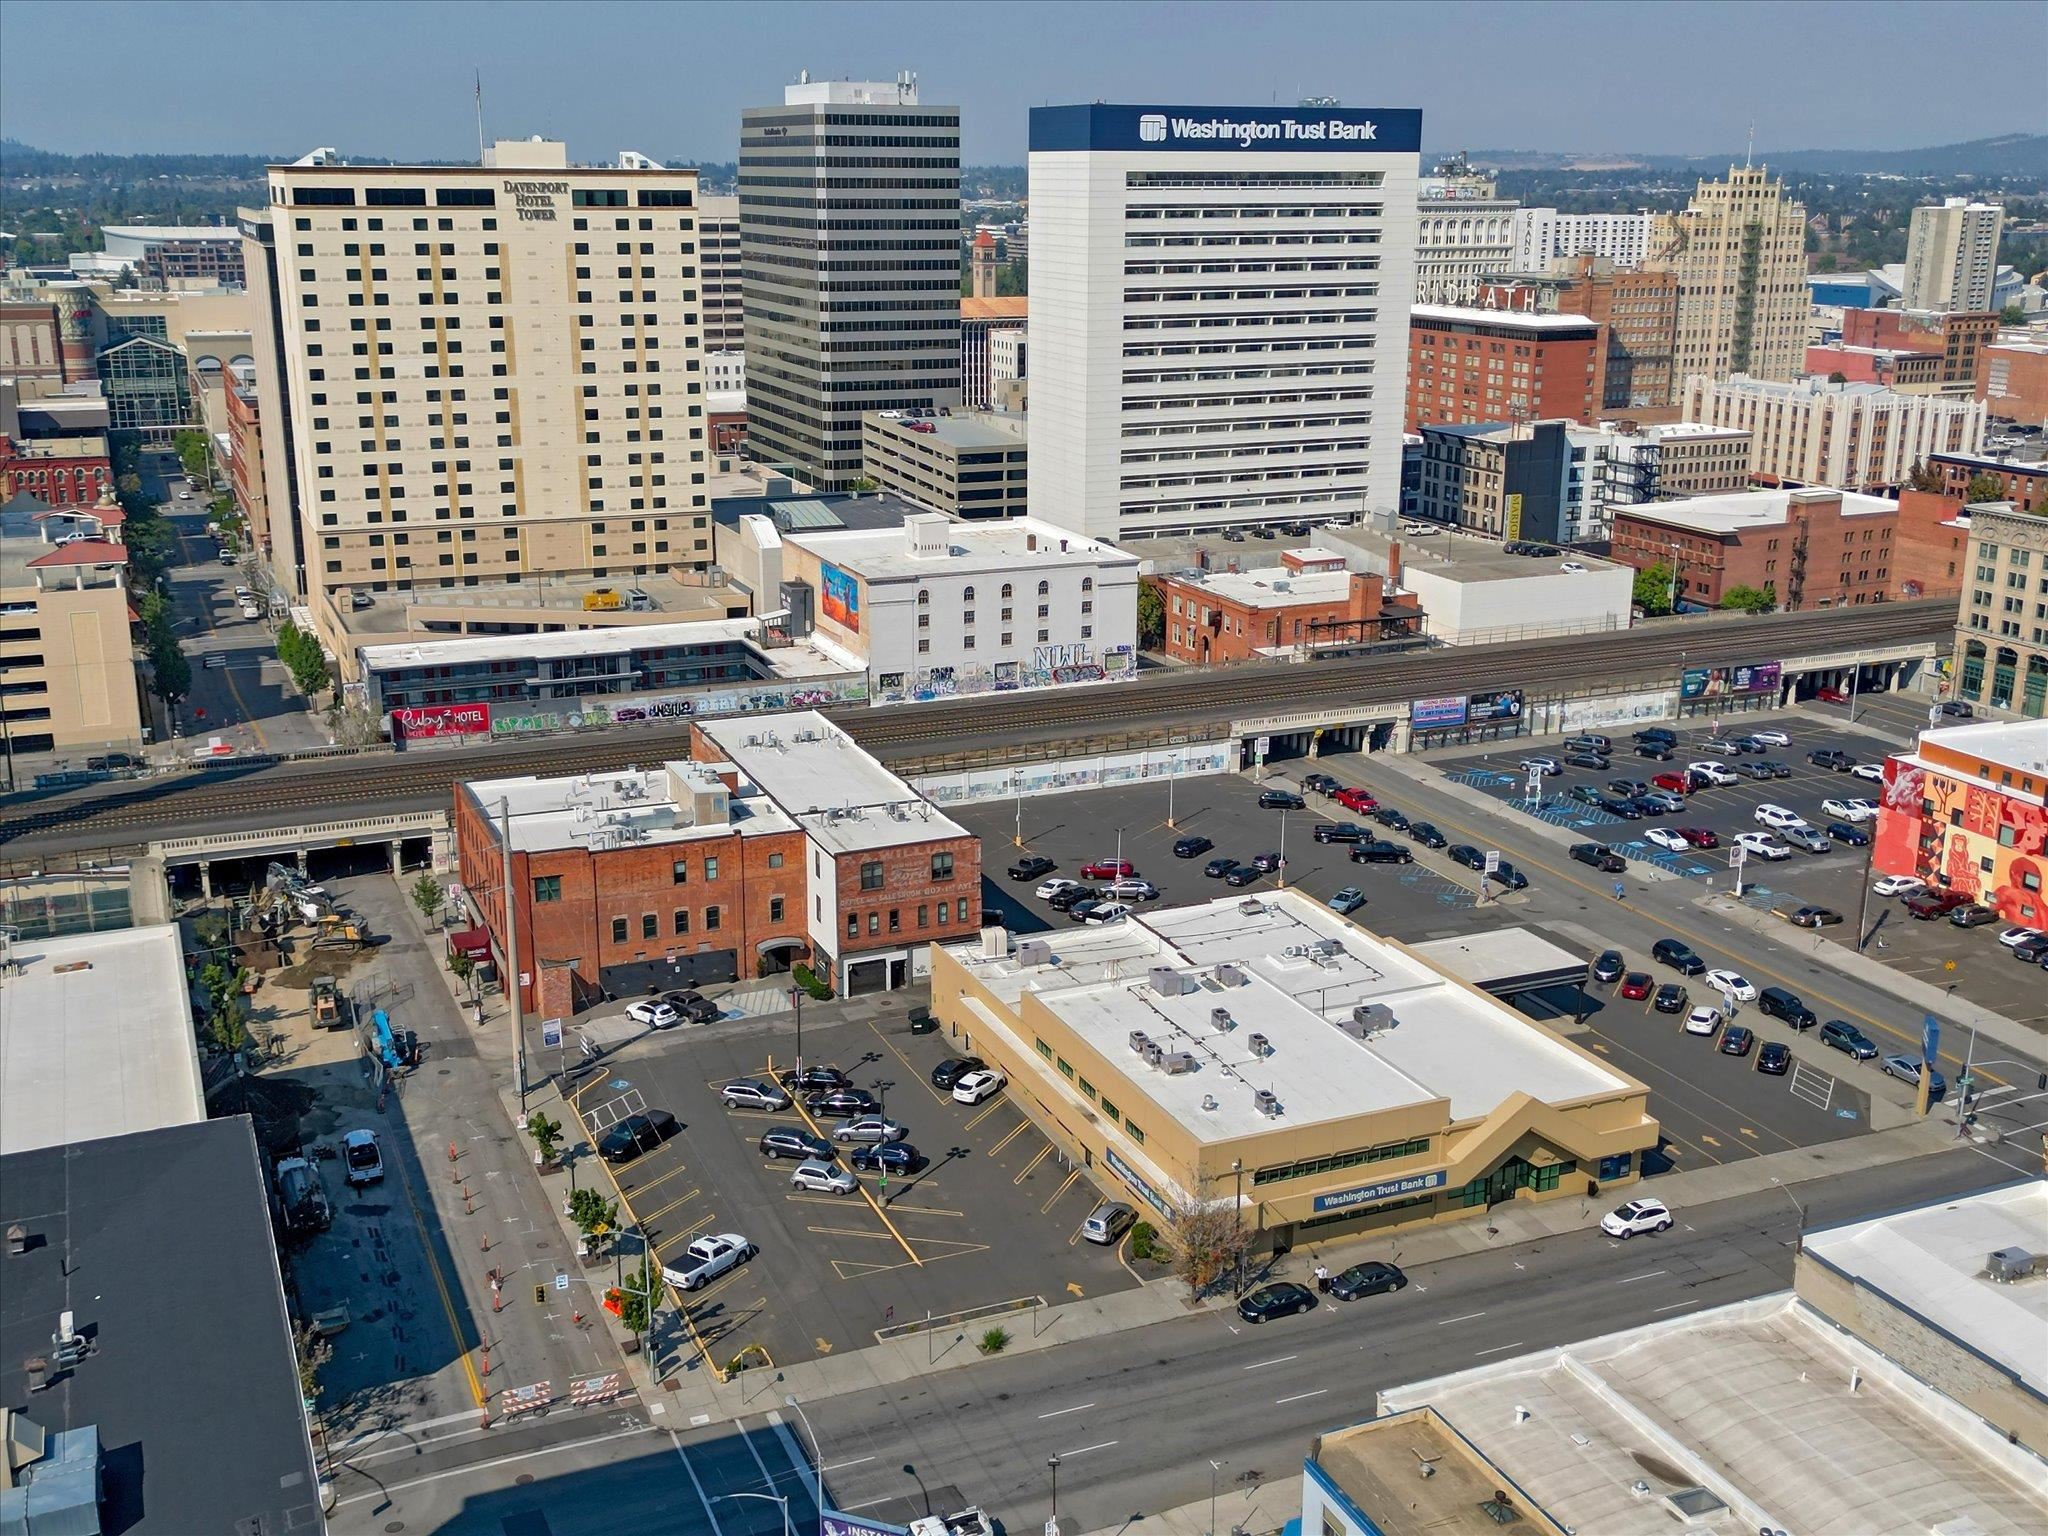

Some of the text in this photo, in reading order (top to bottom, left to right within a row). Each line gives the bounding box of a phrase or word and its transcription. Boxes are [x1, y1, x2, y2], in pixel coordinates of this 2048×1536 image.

[1171, 118, 1377, 147] Washington Trust Bank
[516, 208, 557, 221] TOWER
[1524, 211, 1533, 255] GRAND
[1417, 281, 1536, 312] RIDPATH
[454, 711, 485, 723] HOTEL
[1324, 1178, 1424, 1206] Washington Trust Bank
